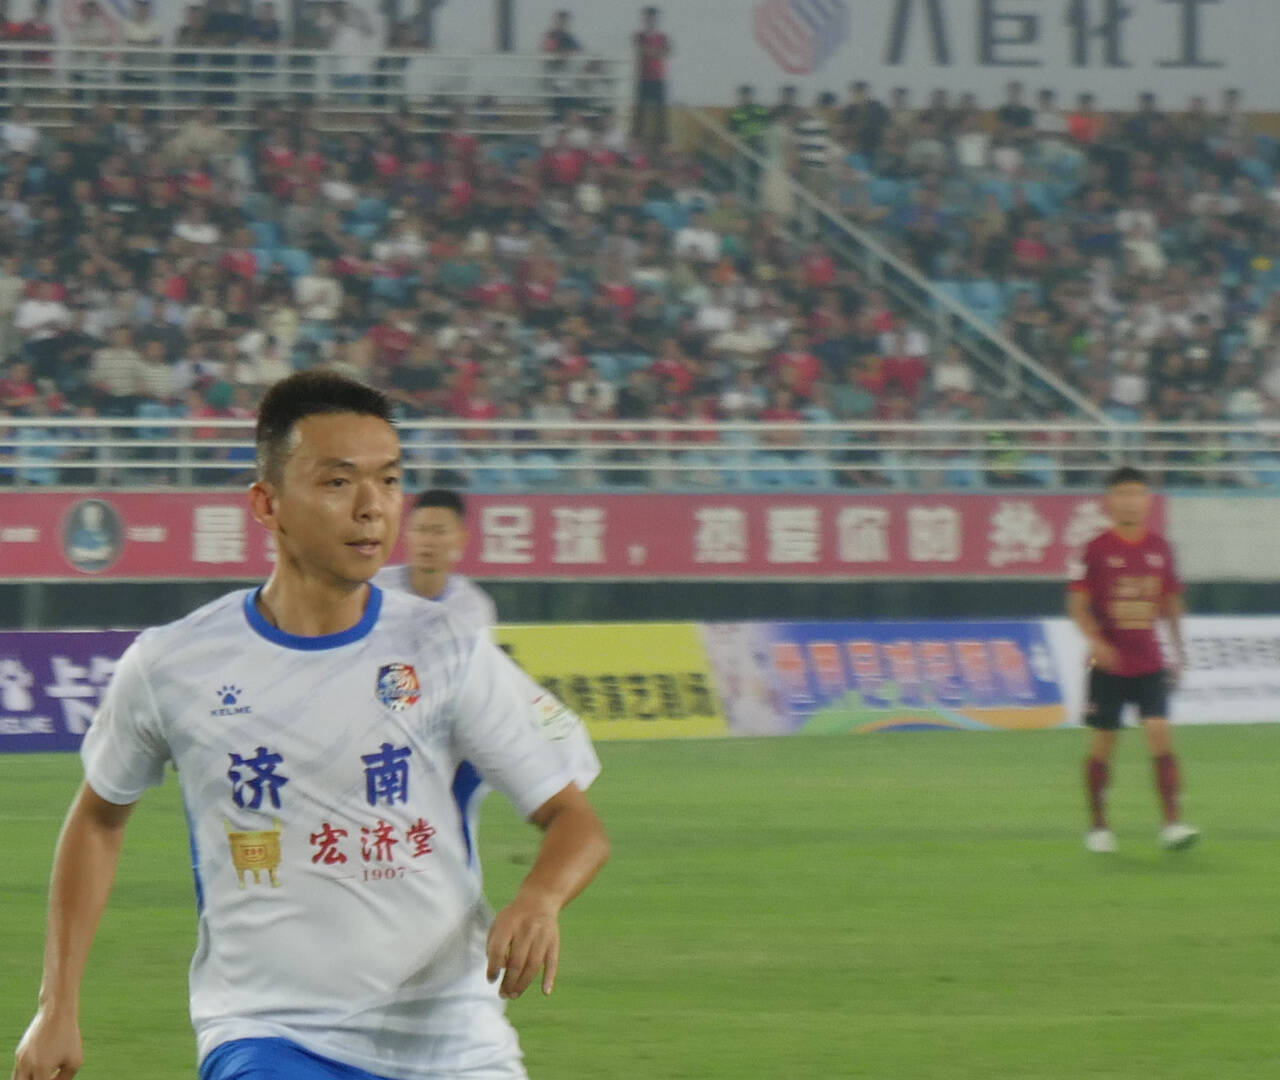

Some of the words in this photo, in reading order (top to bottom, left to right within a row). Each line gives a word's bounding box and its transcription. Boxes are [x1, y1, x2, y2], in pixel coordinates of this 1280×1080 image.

[210, 704, 253, 718] KELME
[309, 818, 436, 866] 宏济堂
[361, 866, 408, 882] 1907
